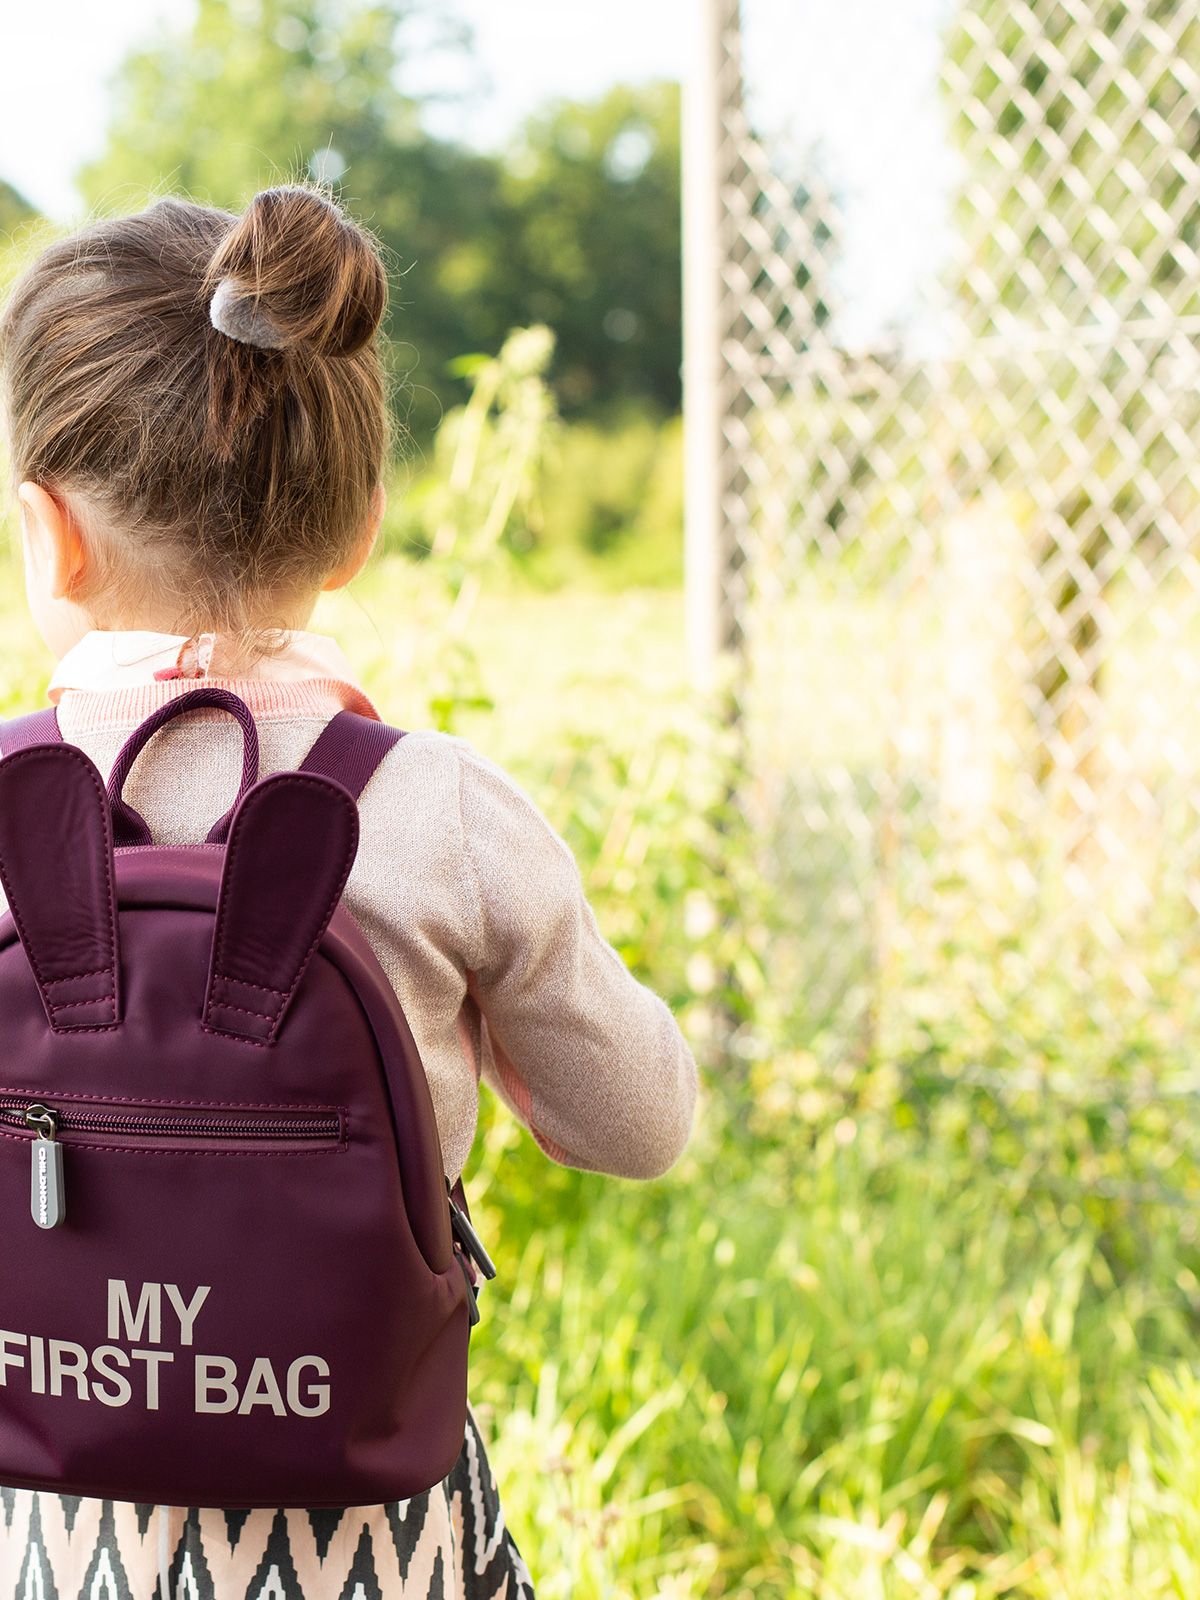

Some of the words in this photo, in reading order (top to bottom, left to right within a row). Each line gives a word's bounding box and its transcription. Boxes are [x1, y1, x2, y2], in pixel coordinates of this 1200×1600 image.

[39, 1146, 47, 1225] CHILDHOME
[107, 1278, 212, 1346] MY
[194, 1354, 331, 1418] BAG
